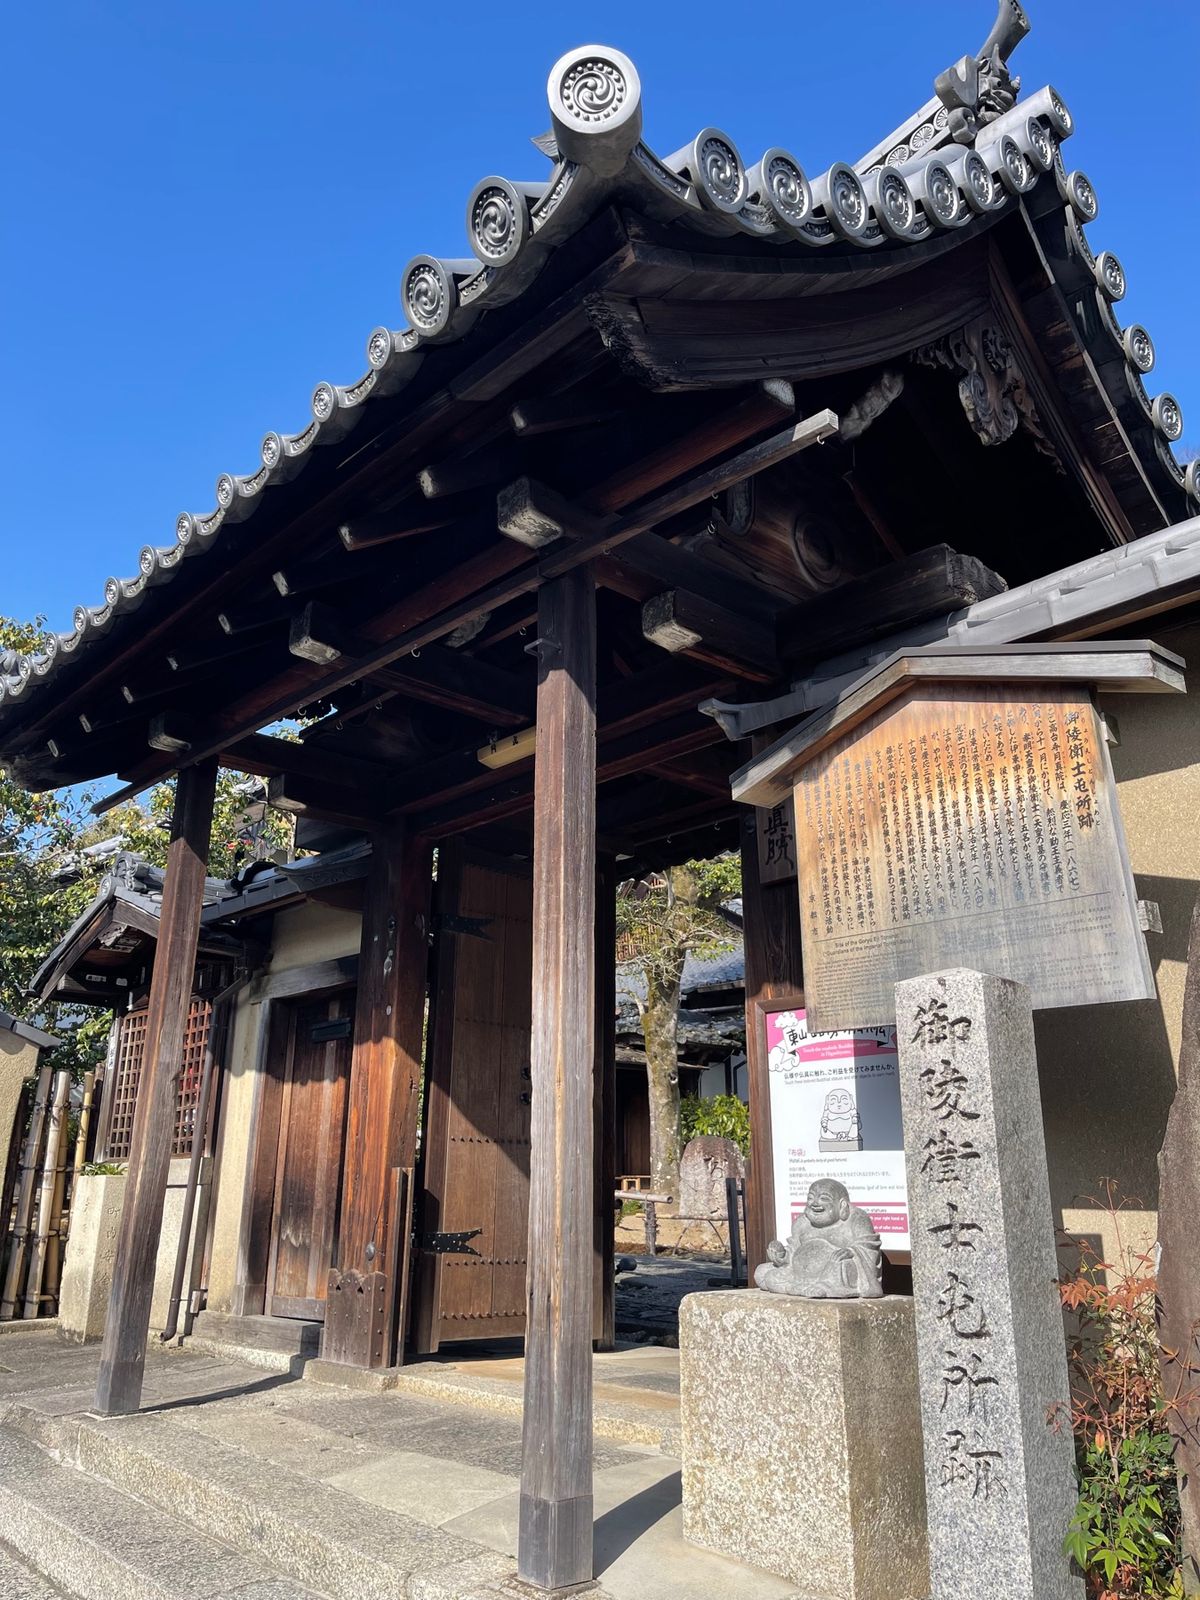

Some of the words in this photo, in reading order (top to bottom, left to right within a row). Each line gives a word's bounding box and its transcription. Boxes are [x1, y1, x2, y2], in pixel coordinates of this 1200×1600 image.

[1063, 710, 1095, 829] 御陵衛士屯所跡
[911, 998, 1008, 1498] 御陵衛士屯所跡
